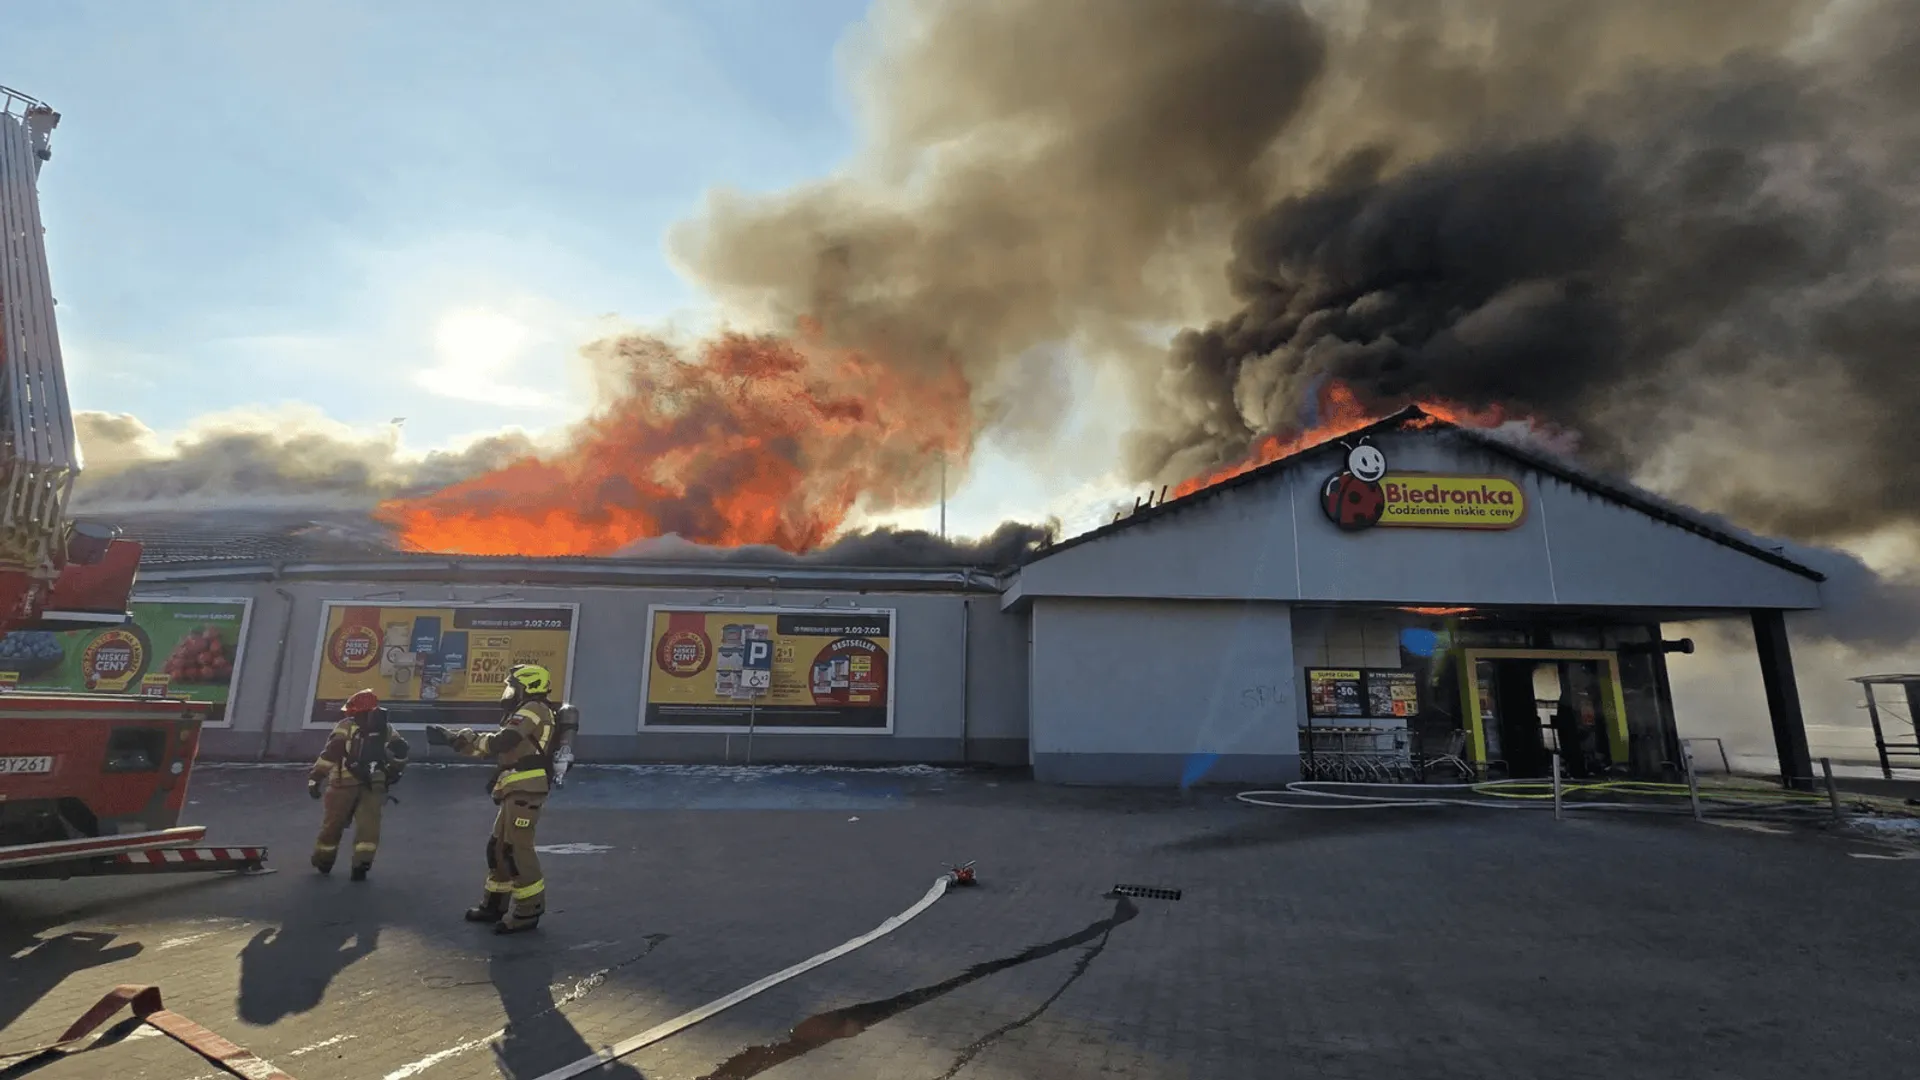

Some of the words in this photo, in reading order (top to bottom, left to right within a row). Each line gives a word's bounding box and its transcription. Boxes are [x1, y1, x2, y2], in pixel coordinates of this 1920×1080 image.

[1385, 483, 1514, 505] Biedronka
[1387, 505, 1450, 516] Codziennie
[1454, 506, 1486, 517] niskie
[1490, 508, 1515, 519] ceny
[524, 620, 562, 628] 2.02-7.02
[845, 626, 881, 634] 2.02-7.02
[832, 639, 876, 652] BESTSELLER
[96, 653, 130, 661] NISKIE
[749, 641, 768, 665] P
[95, 661, 128, 671] CENY
[472, 658, 506, 672] 50%
[471, 674, 505, 684] TANIEJ
